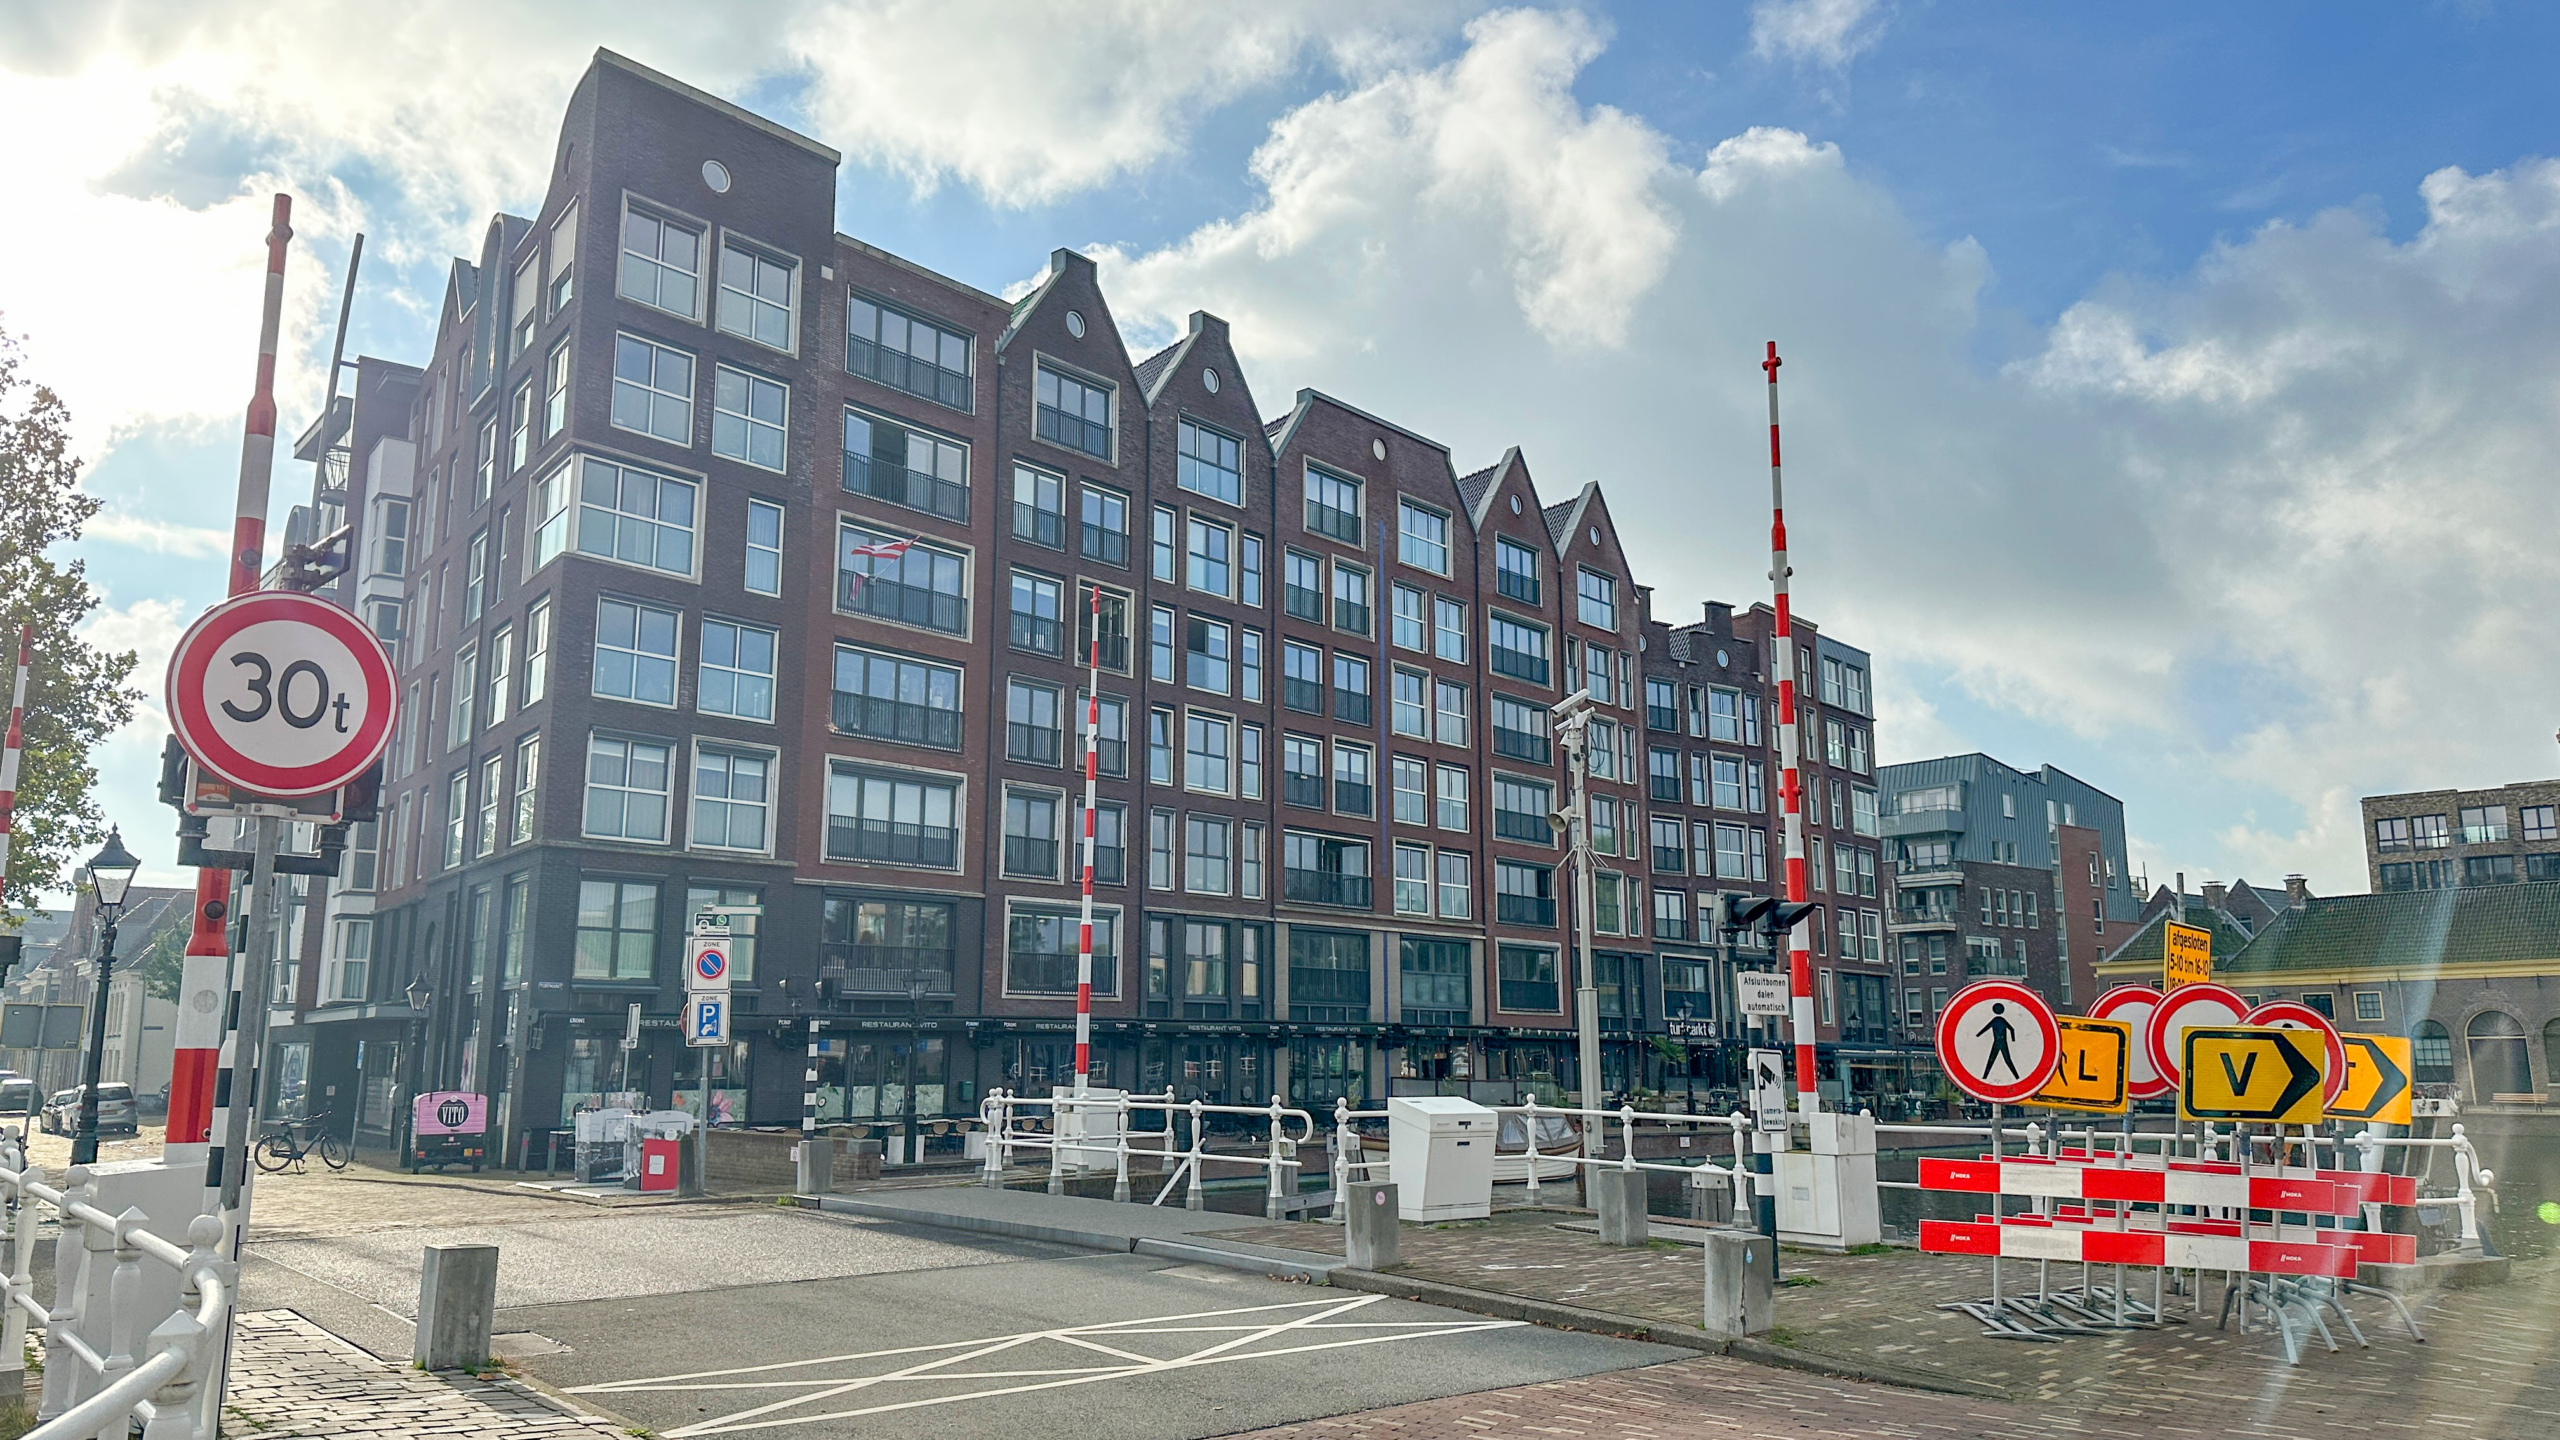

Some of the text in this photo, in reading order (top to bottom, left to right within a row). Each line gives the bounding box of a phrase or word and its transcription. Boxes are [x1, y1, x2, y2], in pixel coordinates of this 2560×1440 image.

[2172, 930, 2208, 952] afgesloten
[2170, 953, 2184, 971] 5-10
[1744, 976, 1786, 986] Afsluitbomen
[1757, 990, 1774, 998] dalen
[1747, 1002, 1785, 1011] automatisch
[2078, 1049, 2098, 1082] L
[2219, 1052, 2258, 1097] V
[442, 1106, 465, 1124] VITO
